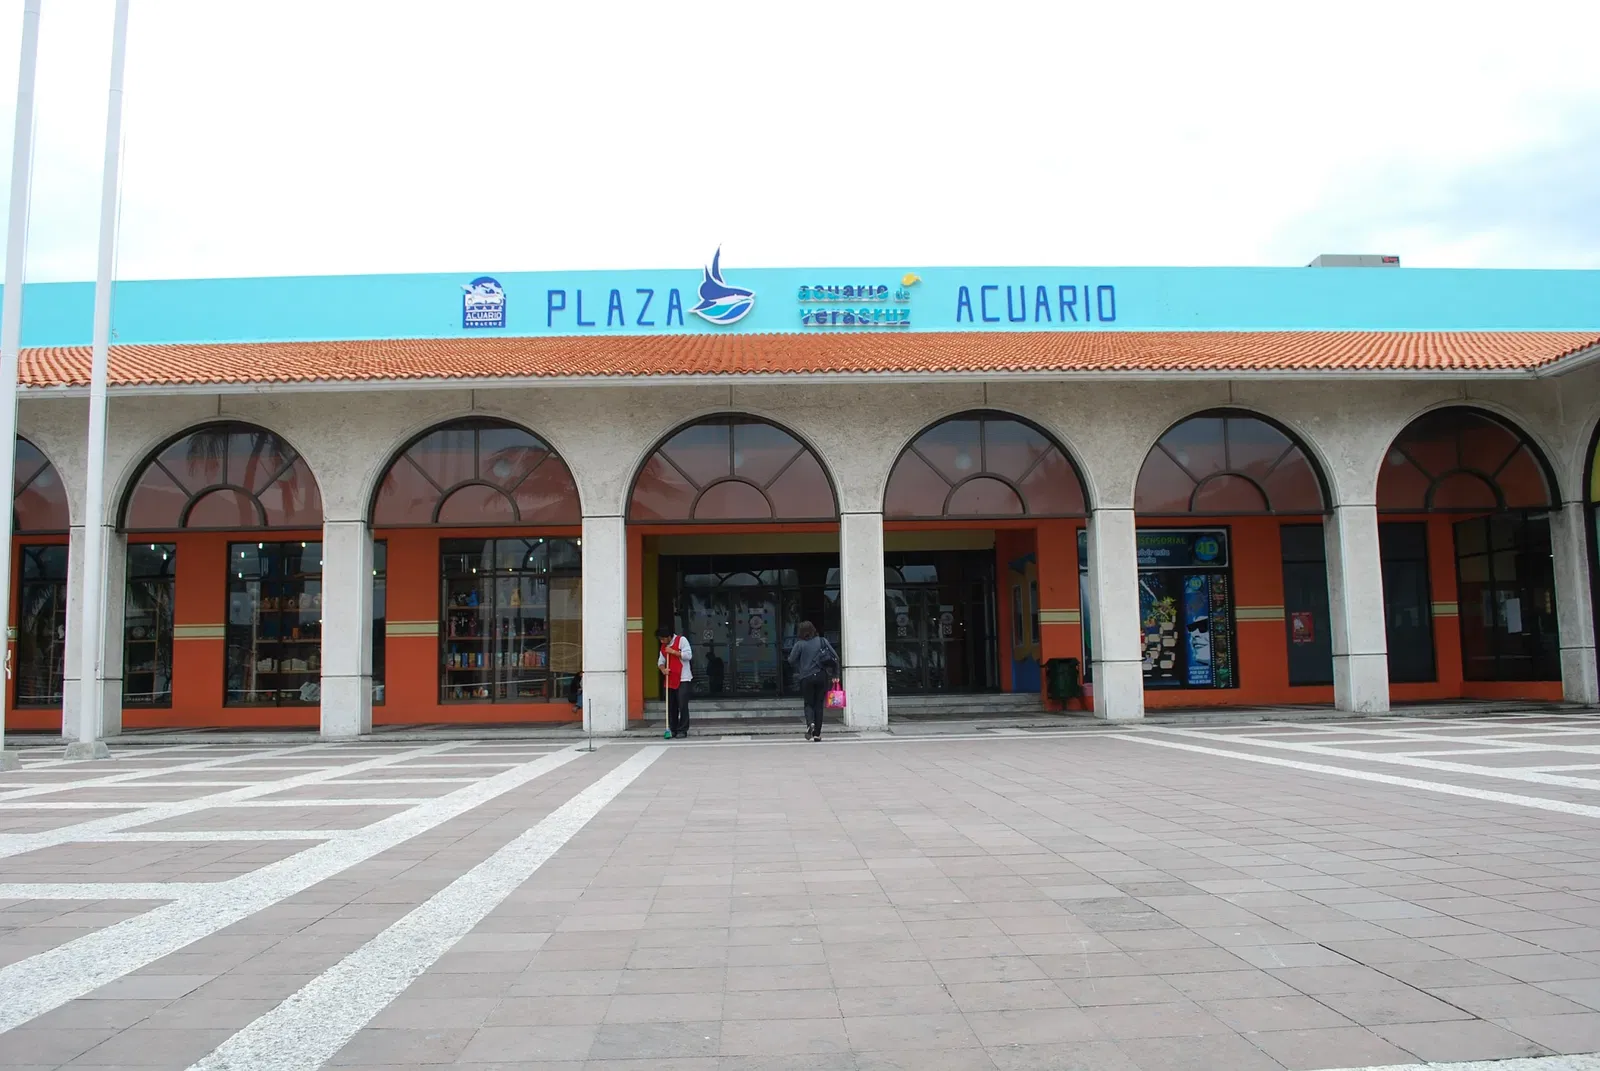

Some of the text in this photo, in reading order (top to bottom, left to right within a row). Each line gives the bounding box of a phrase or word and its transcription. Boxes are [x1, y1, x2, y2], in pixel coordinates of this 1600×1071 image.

[798, 285, 889, 300] acuario
[548, 289, 683, 327] PLAZA
[957, 285, 1116, 322] ACUARIO
[799, 308, 911, 324] veracruz
[1196, 541, 1219, 555] 4D
